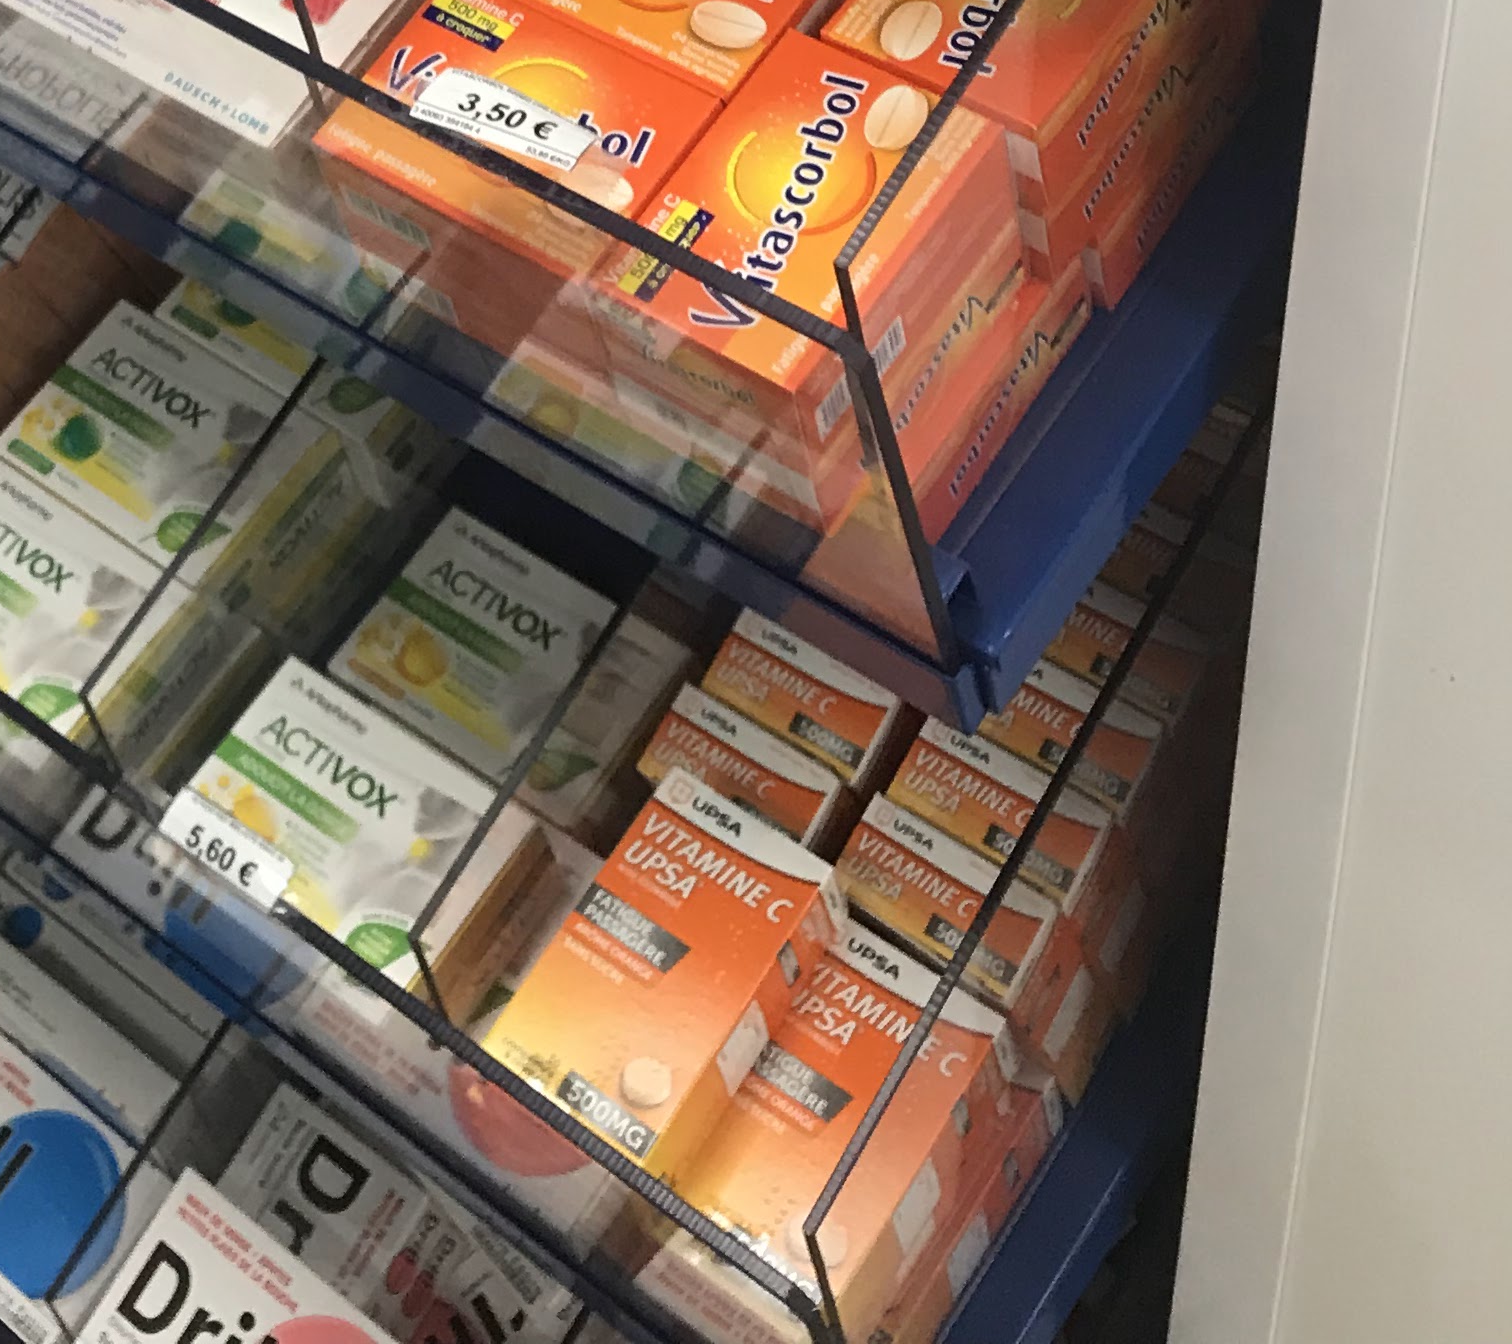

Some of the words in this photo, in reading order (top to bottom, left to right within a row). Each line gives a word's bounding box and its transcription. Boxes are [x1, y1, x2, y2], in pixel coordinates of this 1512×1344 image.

[458, 93, 527, 128] 3,50
[533, 120, 559, 140] €
[91, 346, 214, 430] ACTIVOX
[429, 559, 569, 652] ACTIVOX
[261, 715, 402, 818] ACTIVOX
[185, 824, 238, 873] 5,60
[238, 862, 260, 886] €
[624, 839, 697, 899] UPSA
[642, 812, 771, 908] VITAMINE
[765, 898, 794, 924] C
[847, 934, 902, 980] UPSA
[562, 1078, 647, 1150] 500MG
